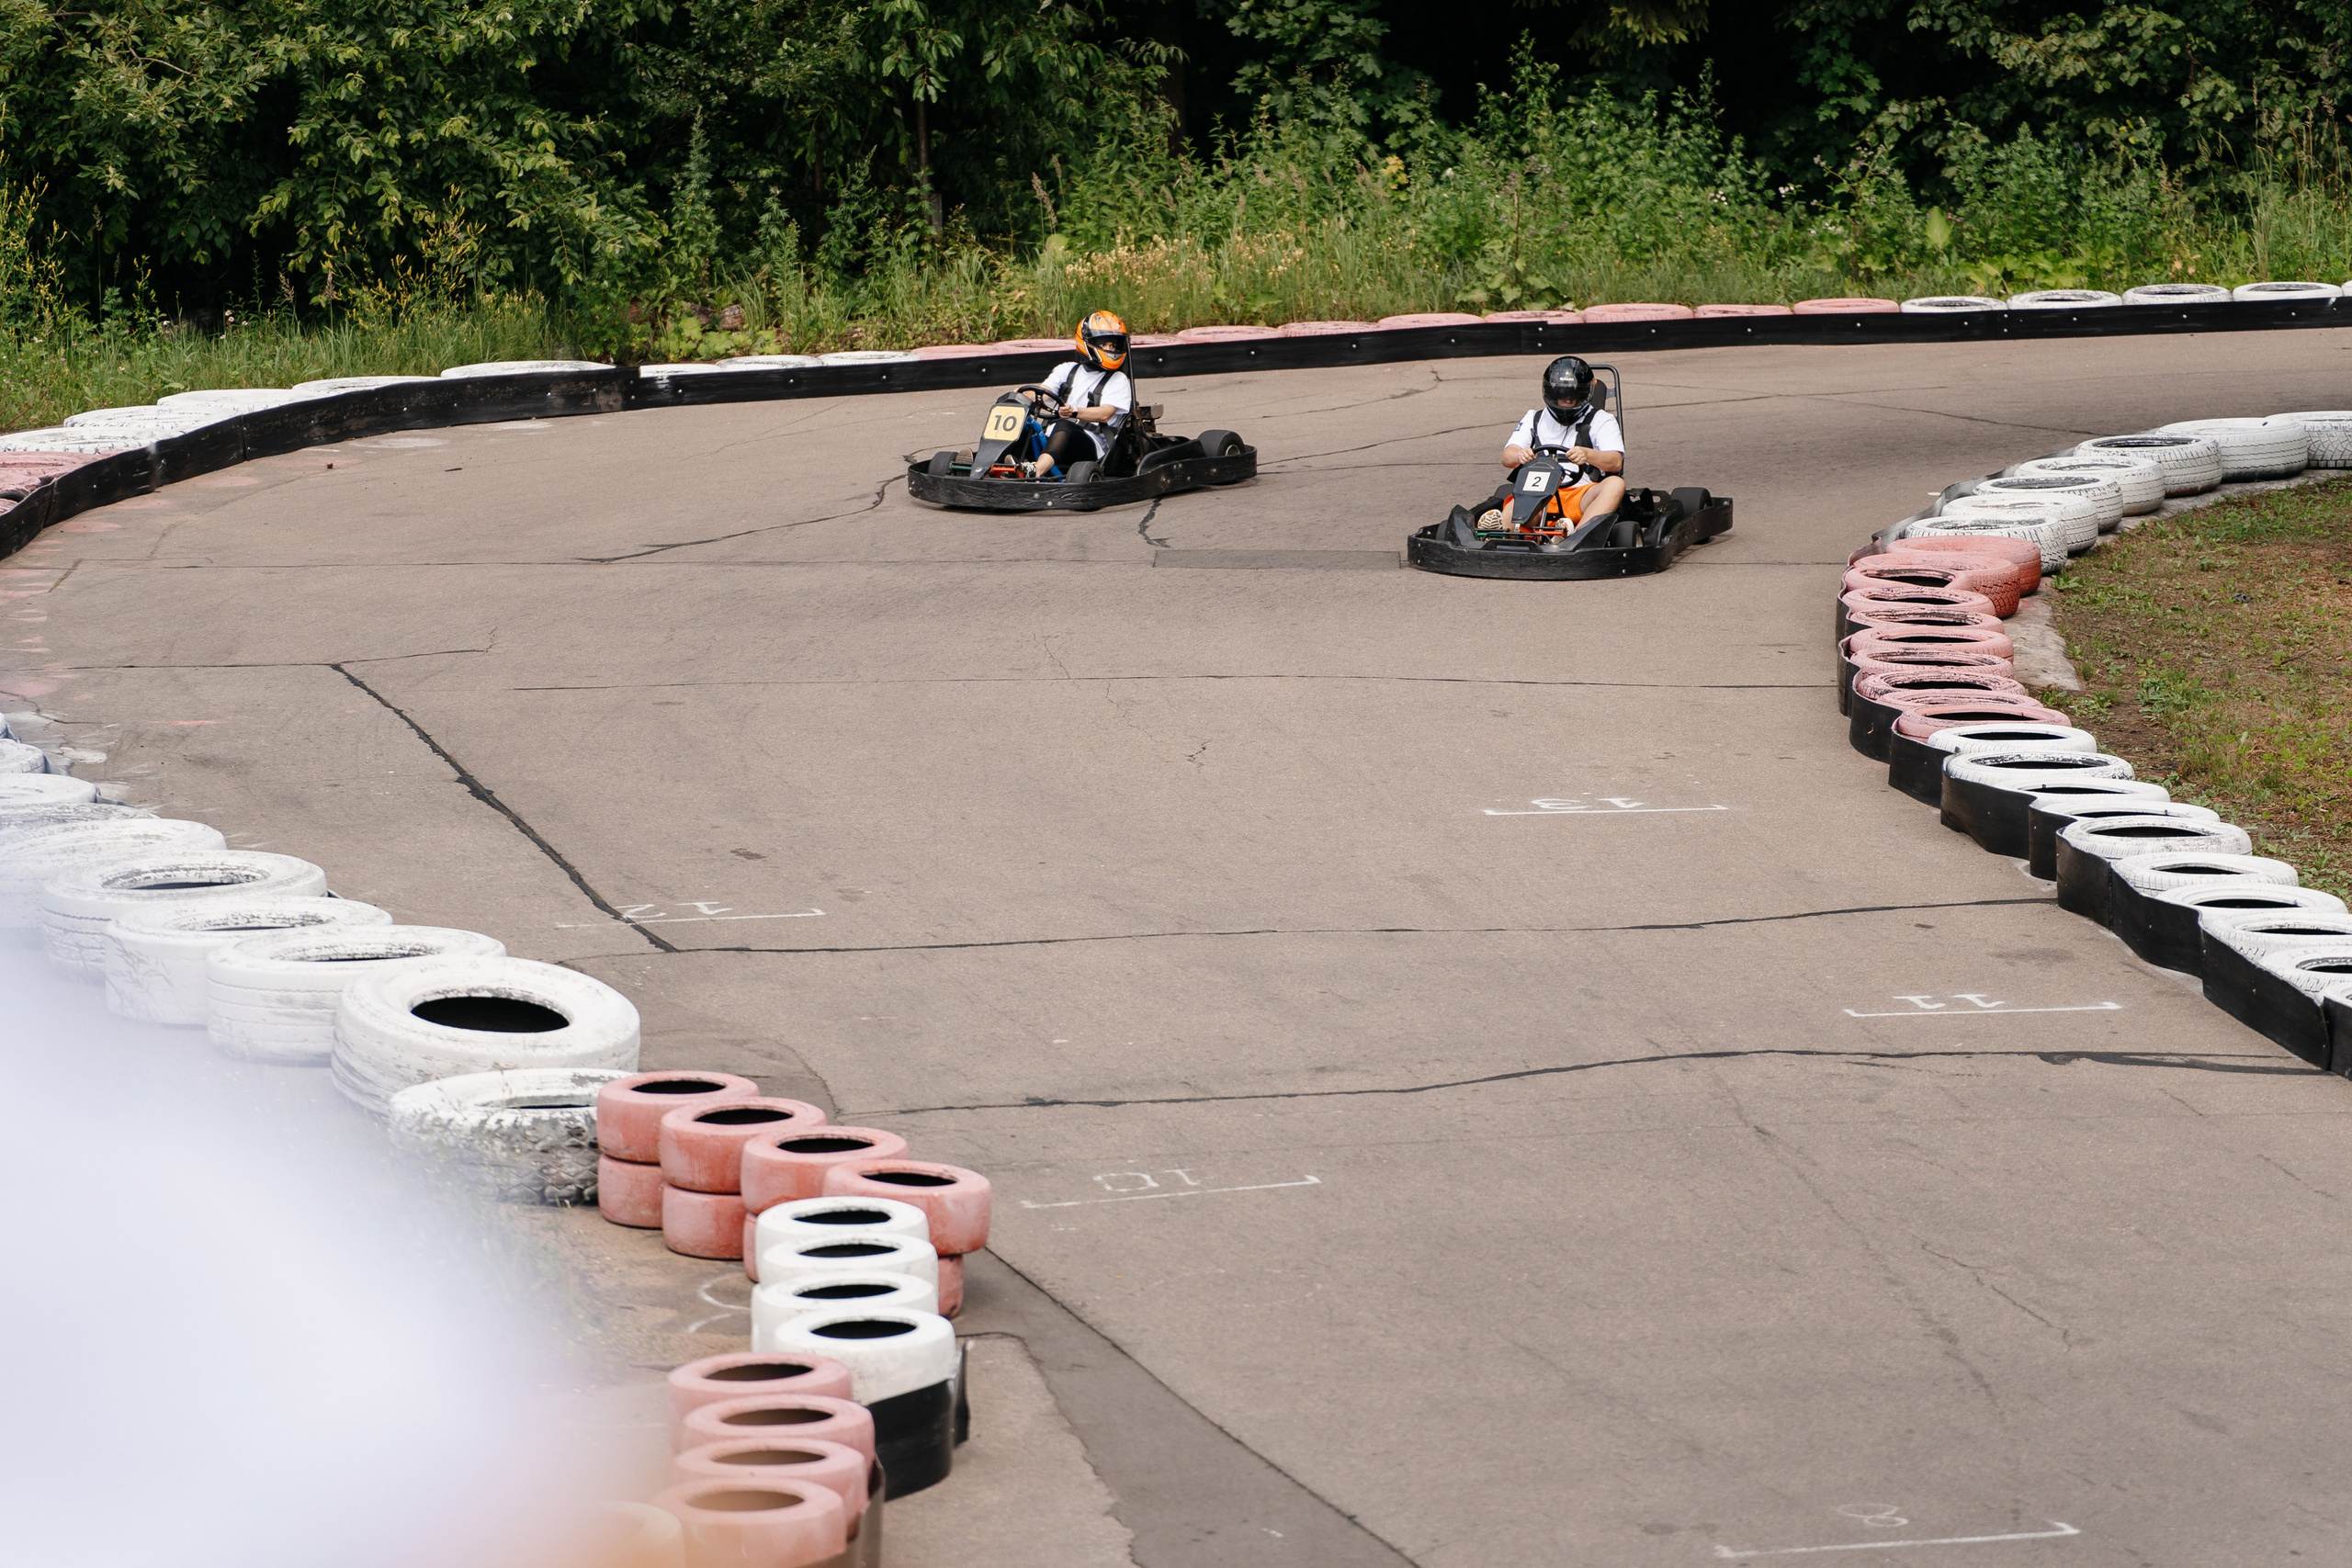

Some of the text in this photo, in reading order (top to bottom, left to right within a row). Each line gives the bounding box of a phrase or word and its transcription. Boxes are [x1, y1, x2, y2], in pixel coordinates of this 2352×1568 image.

[994, 415, 1017, 432] 10
[1532, 476, 1542, 487] 2
[1532, 797, 1645, 809] 13
[614, 901, 733, 919] 12
[1893, 993, 2006, 1010] 11
[1092, 1168, 1213, 1192] 10
[1838, 1503, 1908, 1527] 8
